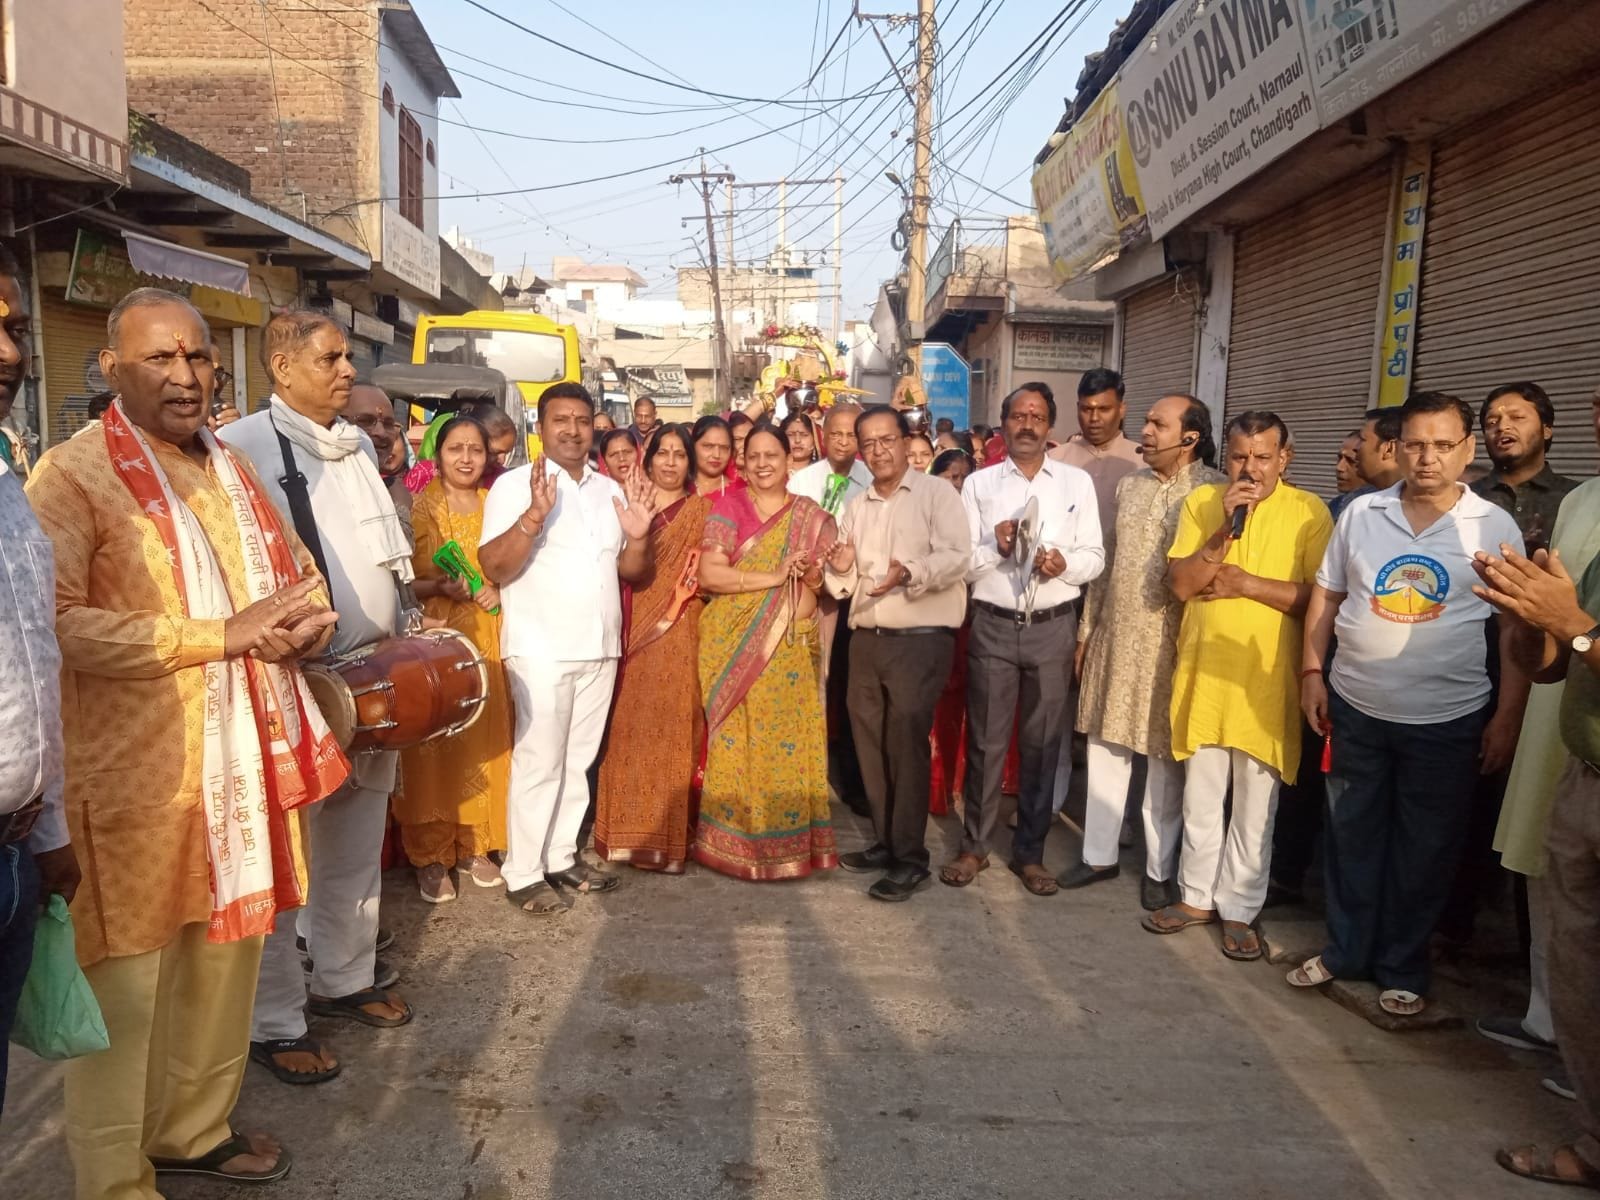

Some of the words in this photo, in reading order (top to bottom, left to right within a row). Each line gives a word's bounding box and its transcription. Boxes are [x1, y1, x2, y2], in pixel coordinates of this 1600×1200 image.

[1143, 47, 1198, 149] SONU
[1193, 0, 1294, 101] DAYMA
[1190, 143, 1198, 162] &
[1197, 119, 1230, 155] Session
[1229, 92, 1260, 129] Court,
[1258, 52, 1304, 104] Narnaul
[1167, 192, 1176, 212] &
[1174, 176, 1203, 208] Haryana
[1202, 160, 1222, 187] High
[1221, 138, 1251, 170] Court,
[1250, 91, 1312, 150] Chandigarh
[233, 774, 249, 802] राम
[241, 828, 256, 852] जय
